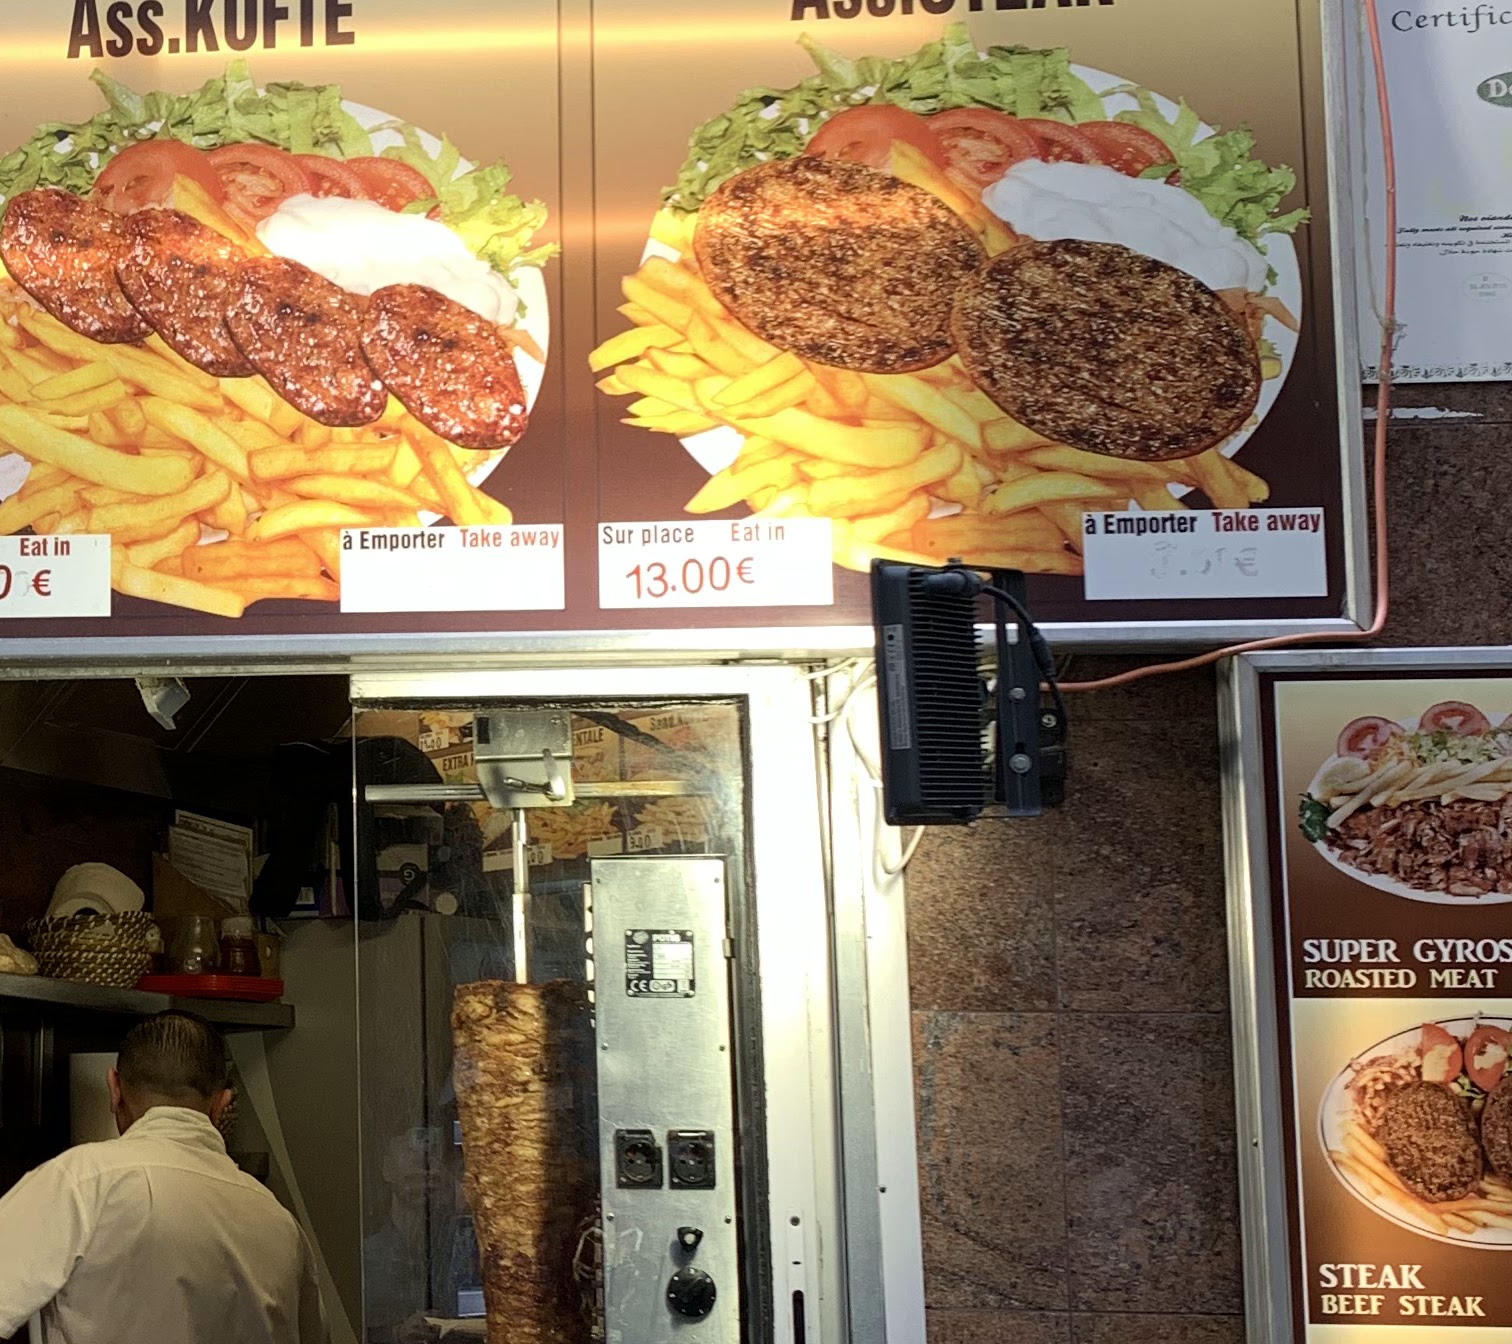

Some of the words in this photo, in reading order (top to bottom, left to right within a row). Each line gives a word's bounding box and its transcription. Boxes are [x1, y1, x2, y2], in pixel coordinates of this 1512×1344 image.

[601, 523, 635, 546] Sur
[641, 524, 695, 548] place
[731, 522, 763, 543] Eat
[768, 522, 786, 542] in
[1085, 514, 1097, 535] à
[1104, 514, 1198, 537] Emporter
[1211, 512, 1259, 533] Take
[1266, 513, 1322, 534] away
[20, 537, 49, 557] Eat
[53, 537, 71, 557] in
[342, 530, 353, 551] à
[359, 530, 446, 553] Emporter
[460, 528, 504, 549] Take
[510, 529, 561, 552] away
[625, 556, 756, 599] 13.00€
[1303, 938, 1400, 963] SUPER
[1413, 938, 1512, 963] GYROS
[1304, 968, 1417, 989] ROASTED
[1429, 968, 1498, 989] MEAT
[1319, 1263, 1425, 1289] STEAK
[1321, 1294, 1385, 1315] BEEF
[1399, 1295, 1486, 1317] STEAK
